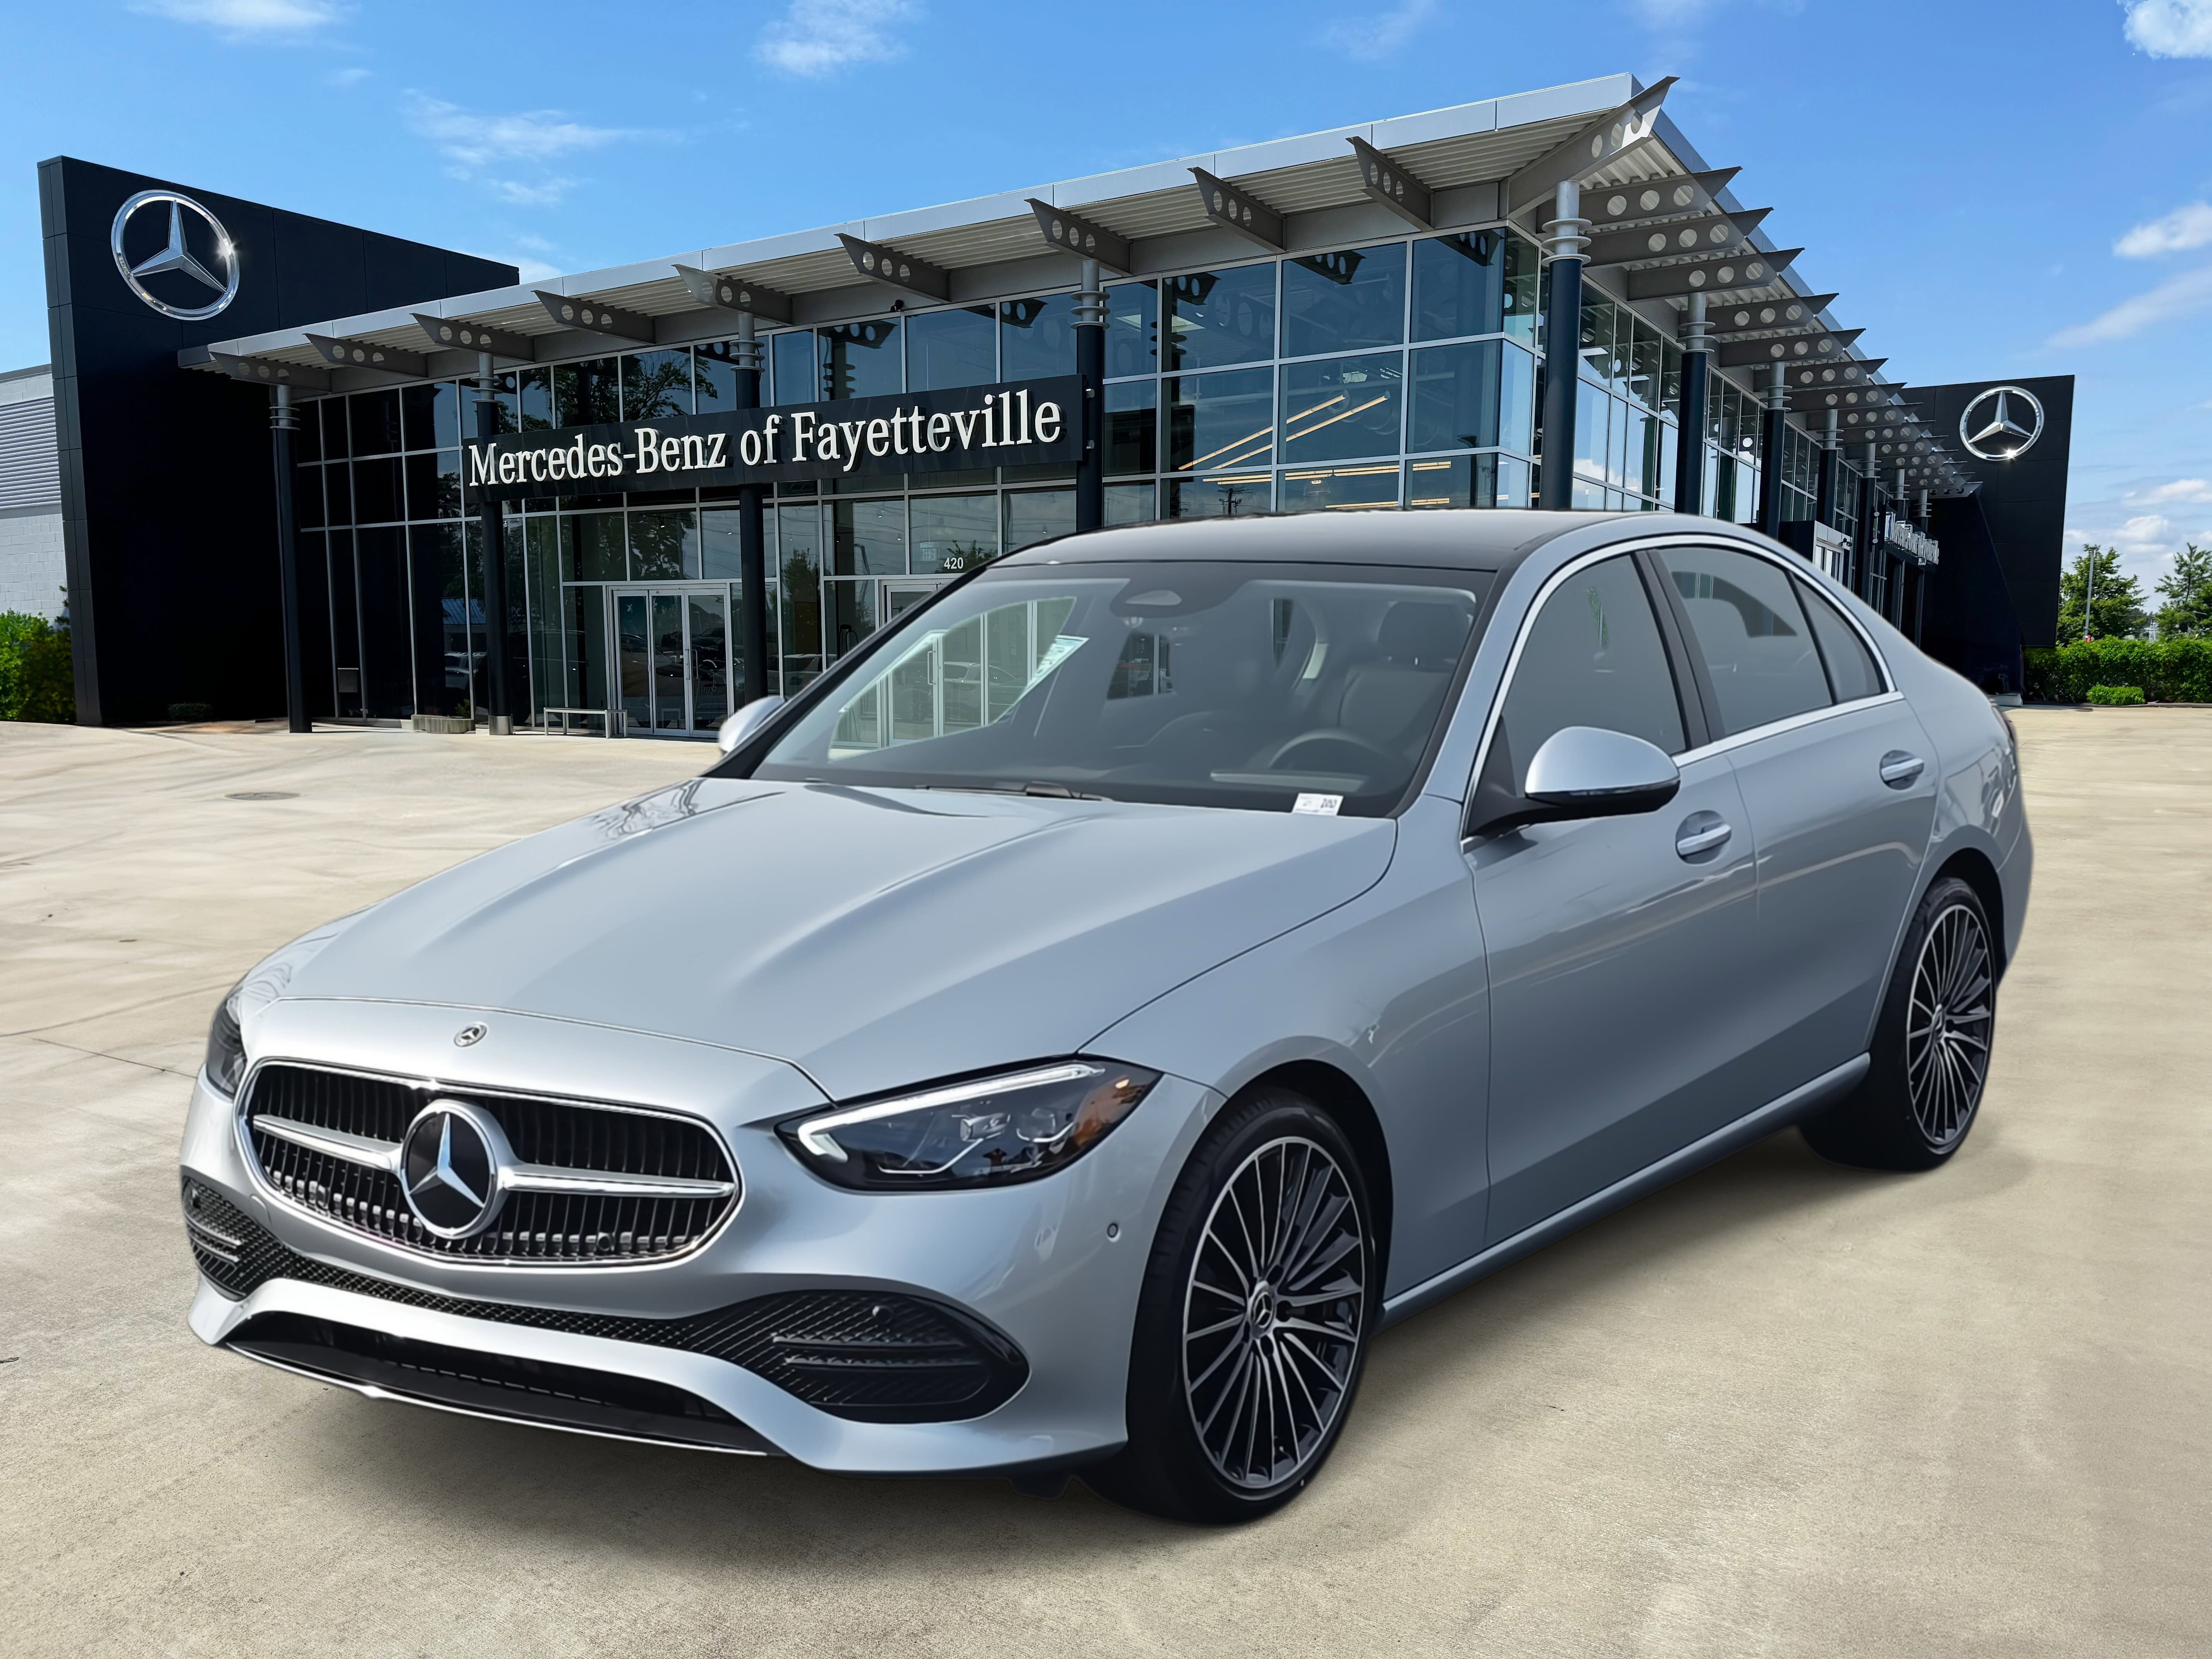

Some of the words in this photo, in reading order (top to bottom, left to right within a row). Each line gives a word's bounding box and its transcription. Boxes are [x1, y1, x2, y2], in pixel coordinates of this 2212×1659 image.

[469, 428, 726, 486] Mercedes-Benz
[740, 414, 781, 465] of
[791, 389, 1061, 472] Fayetteville
[944, 557, 963, 569] 420
